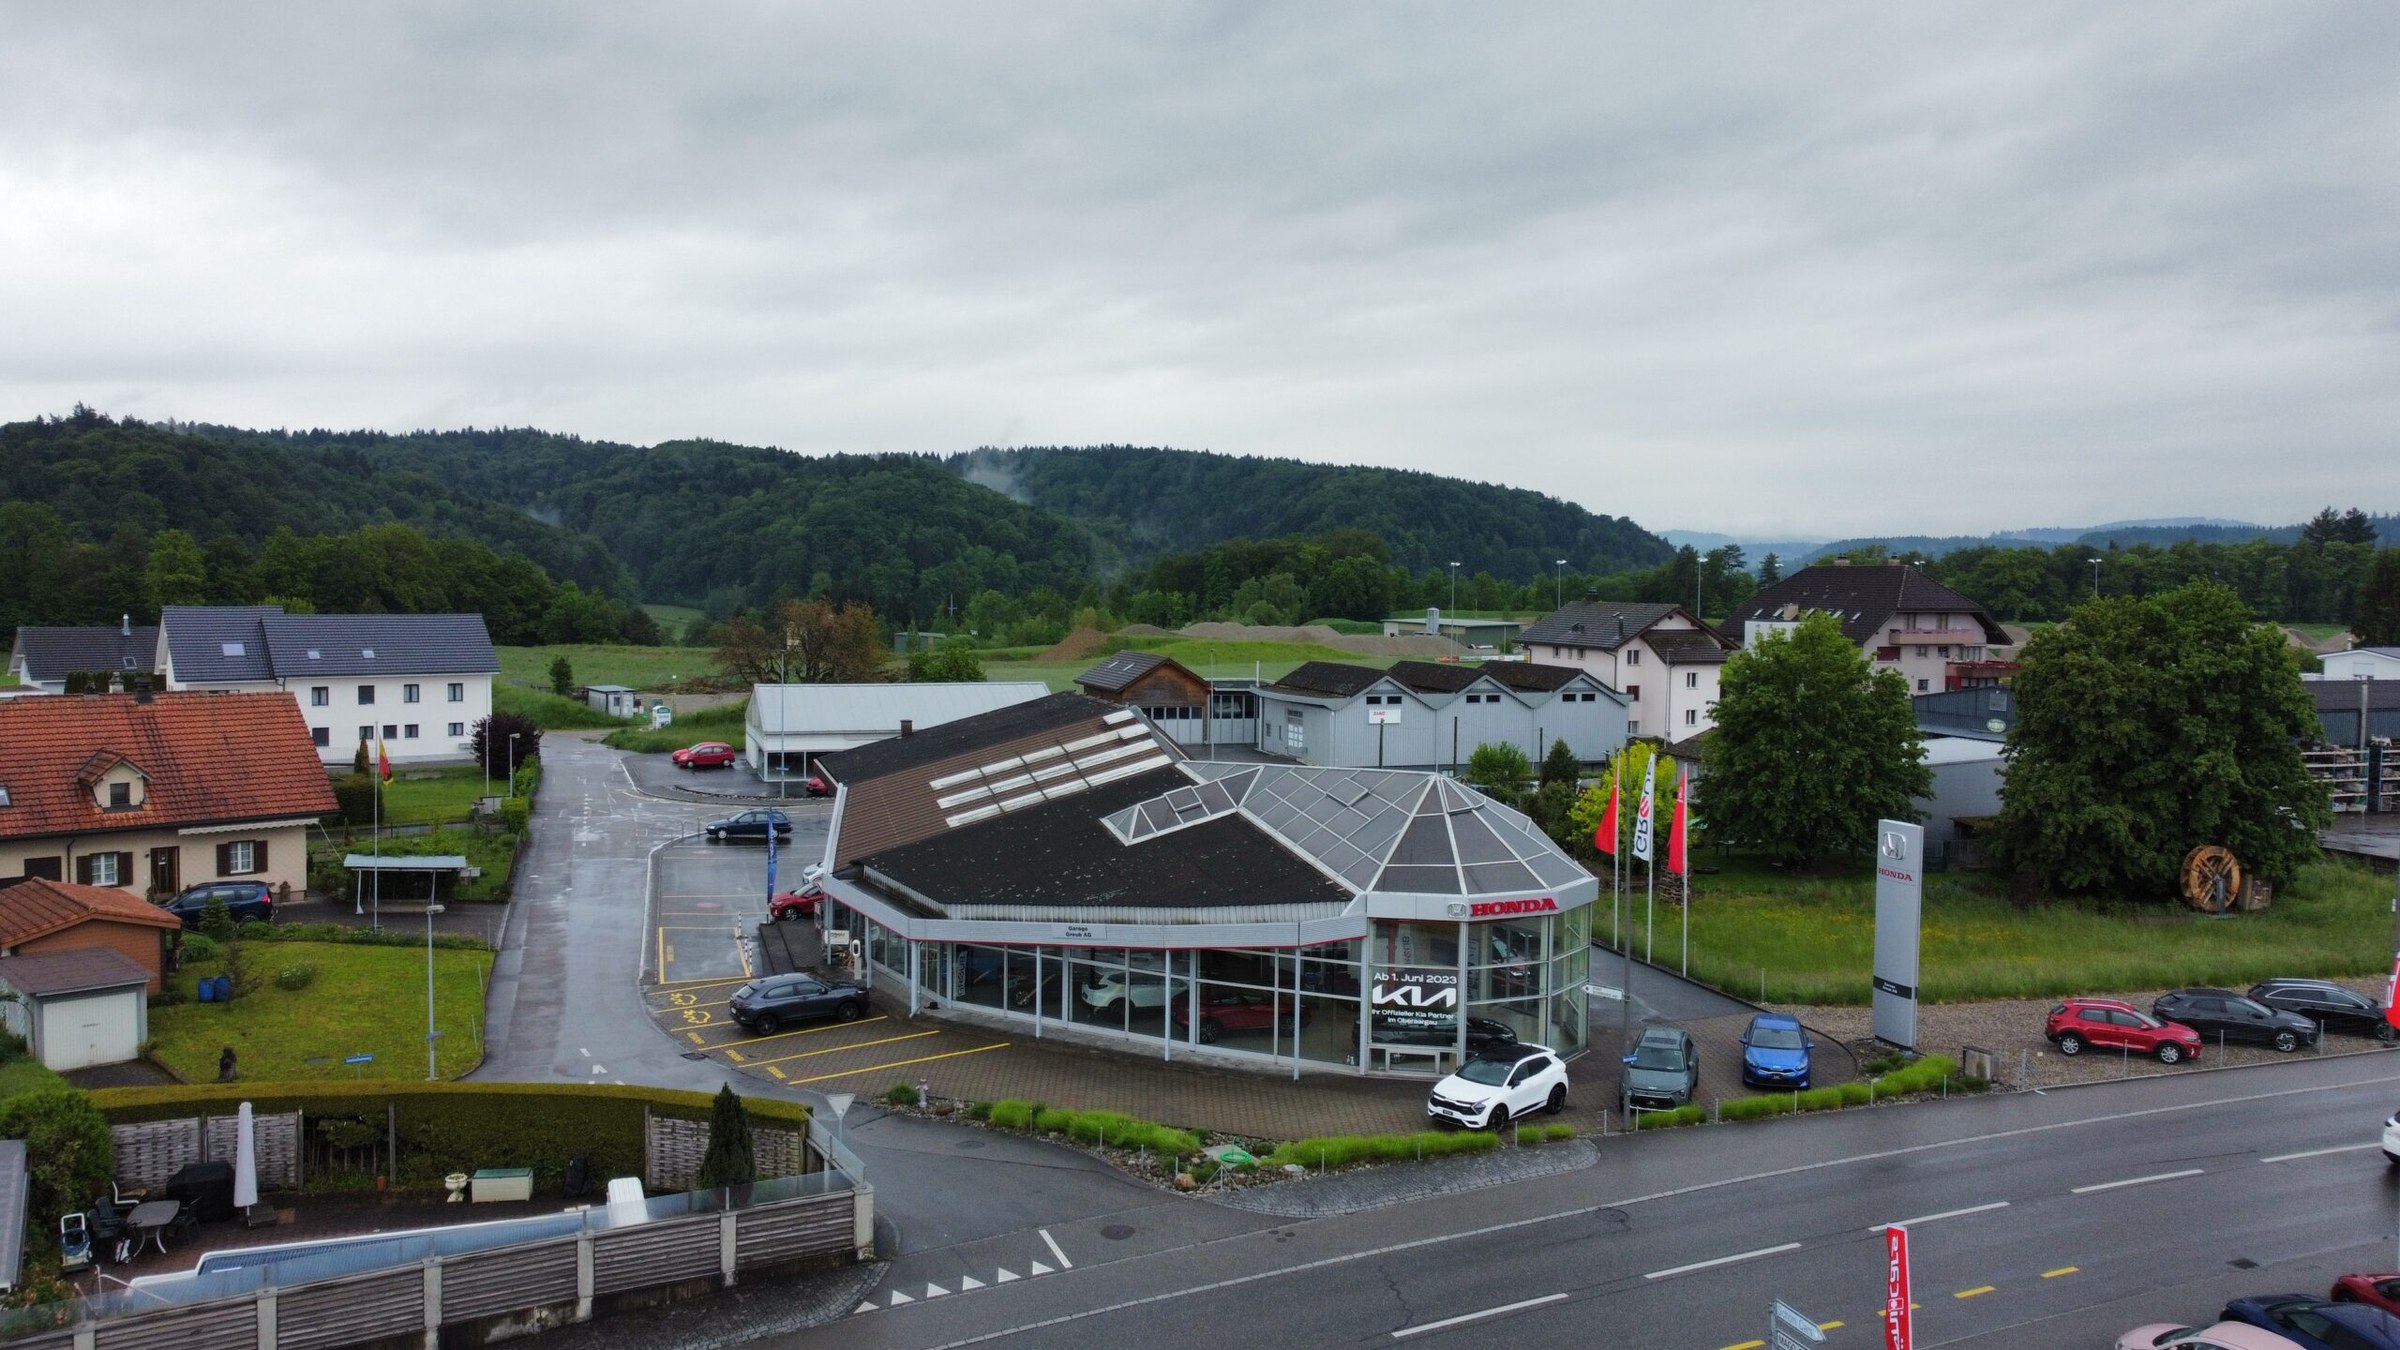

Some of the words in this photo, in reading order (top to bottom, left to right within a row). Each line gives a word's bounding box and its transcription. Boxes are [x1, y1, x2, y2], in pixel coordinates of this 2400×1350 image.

[1878, 867, 1912, 881] HONDA
[1471, 897, 1558, 917] HONDA
[1373, 972, 1389, 981] Ab
[1391, 973, 1399, 981] 1.
[1401, 973, 1424, 983] Juni
[1426, 975, 1457, 984] 2023
[1372, 984, 1457, 1008] KIA
